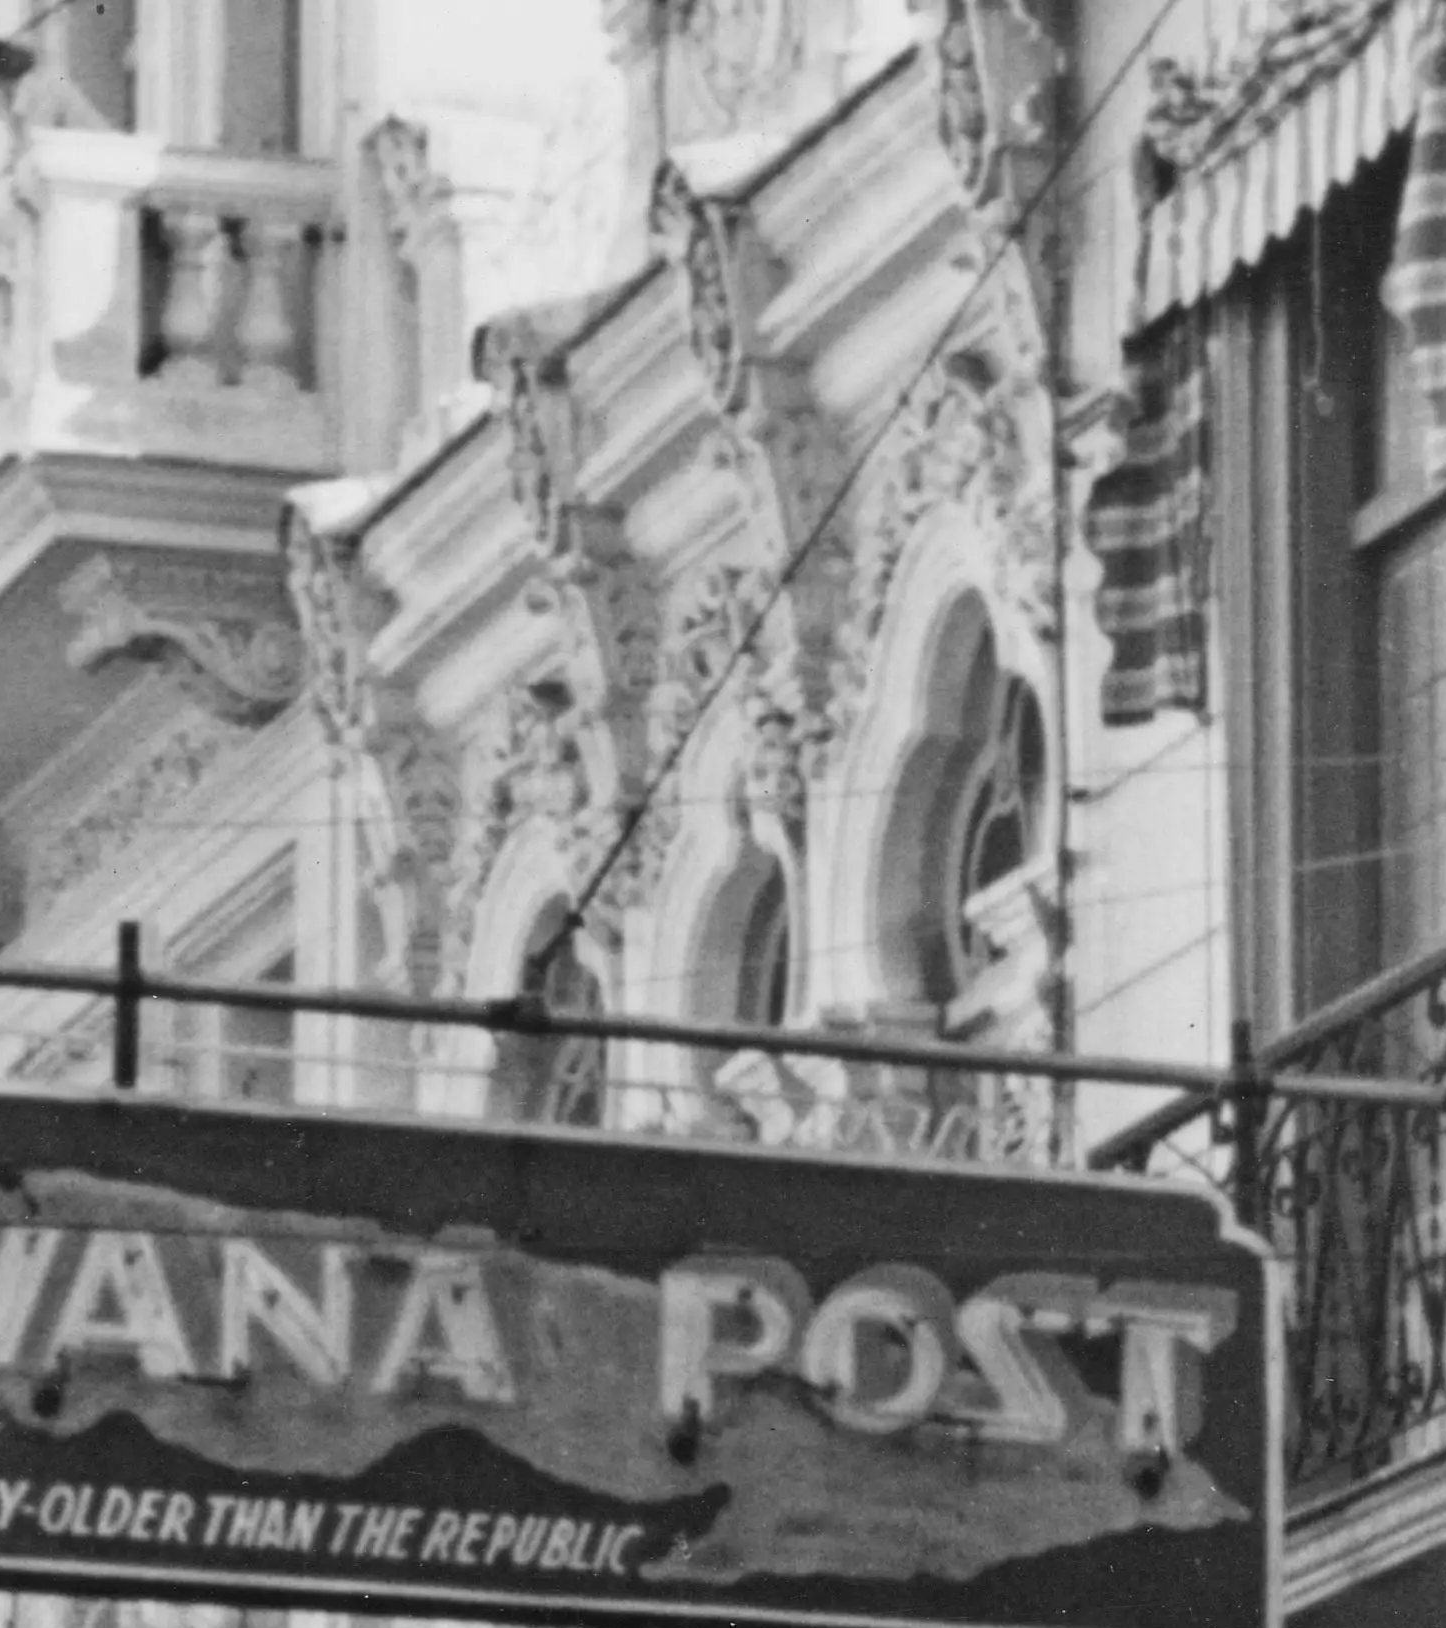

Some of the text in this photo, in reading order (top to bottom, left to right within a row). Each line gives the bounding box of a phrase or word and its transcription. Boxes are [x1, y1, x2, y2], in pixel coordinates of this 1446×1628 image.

[659, 1260, 1229, 1452] POST
[201, 1493, 325, 1554] THAN
[327, 1502, 426, 1561] THE
[418, 1507, 645, 1577] REPUBLIC
